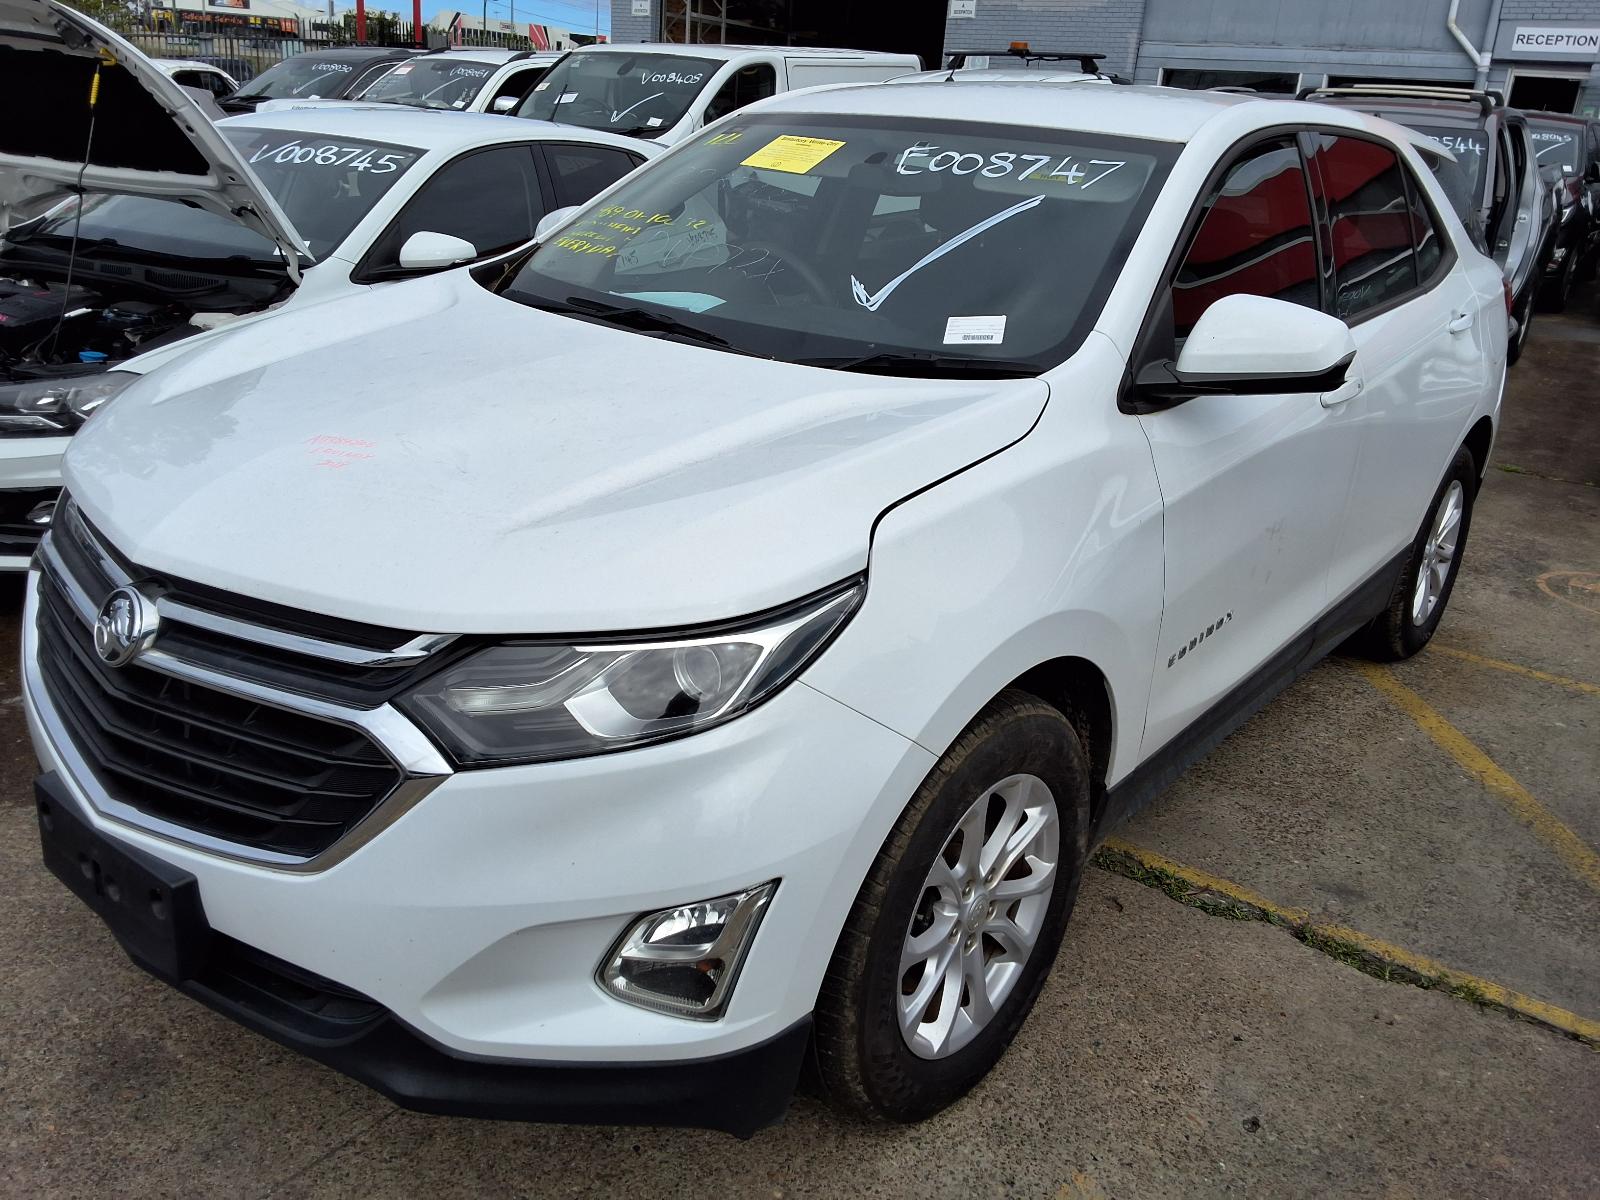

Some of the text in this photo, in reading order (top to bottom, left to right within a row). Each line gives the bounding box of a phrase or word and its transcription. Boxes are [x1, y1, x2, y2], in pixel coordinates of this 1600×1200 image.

[1516, 34, 1598, 46] RECEPTION
[249, 139, 406, 174] V008745
[1430, 135, 1486, 156] 544
[896, 145, 1127, 190] E008747
[1167, 610, 1233, 669] EQUINOX
